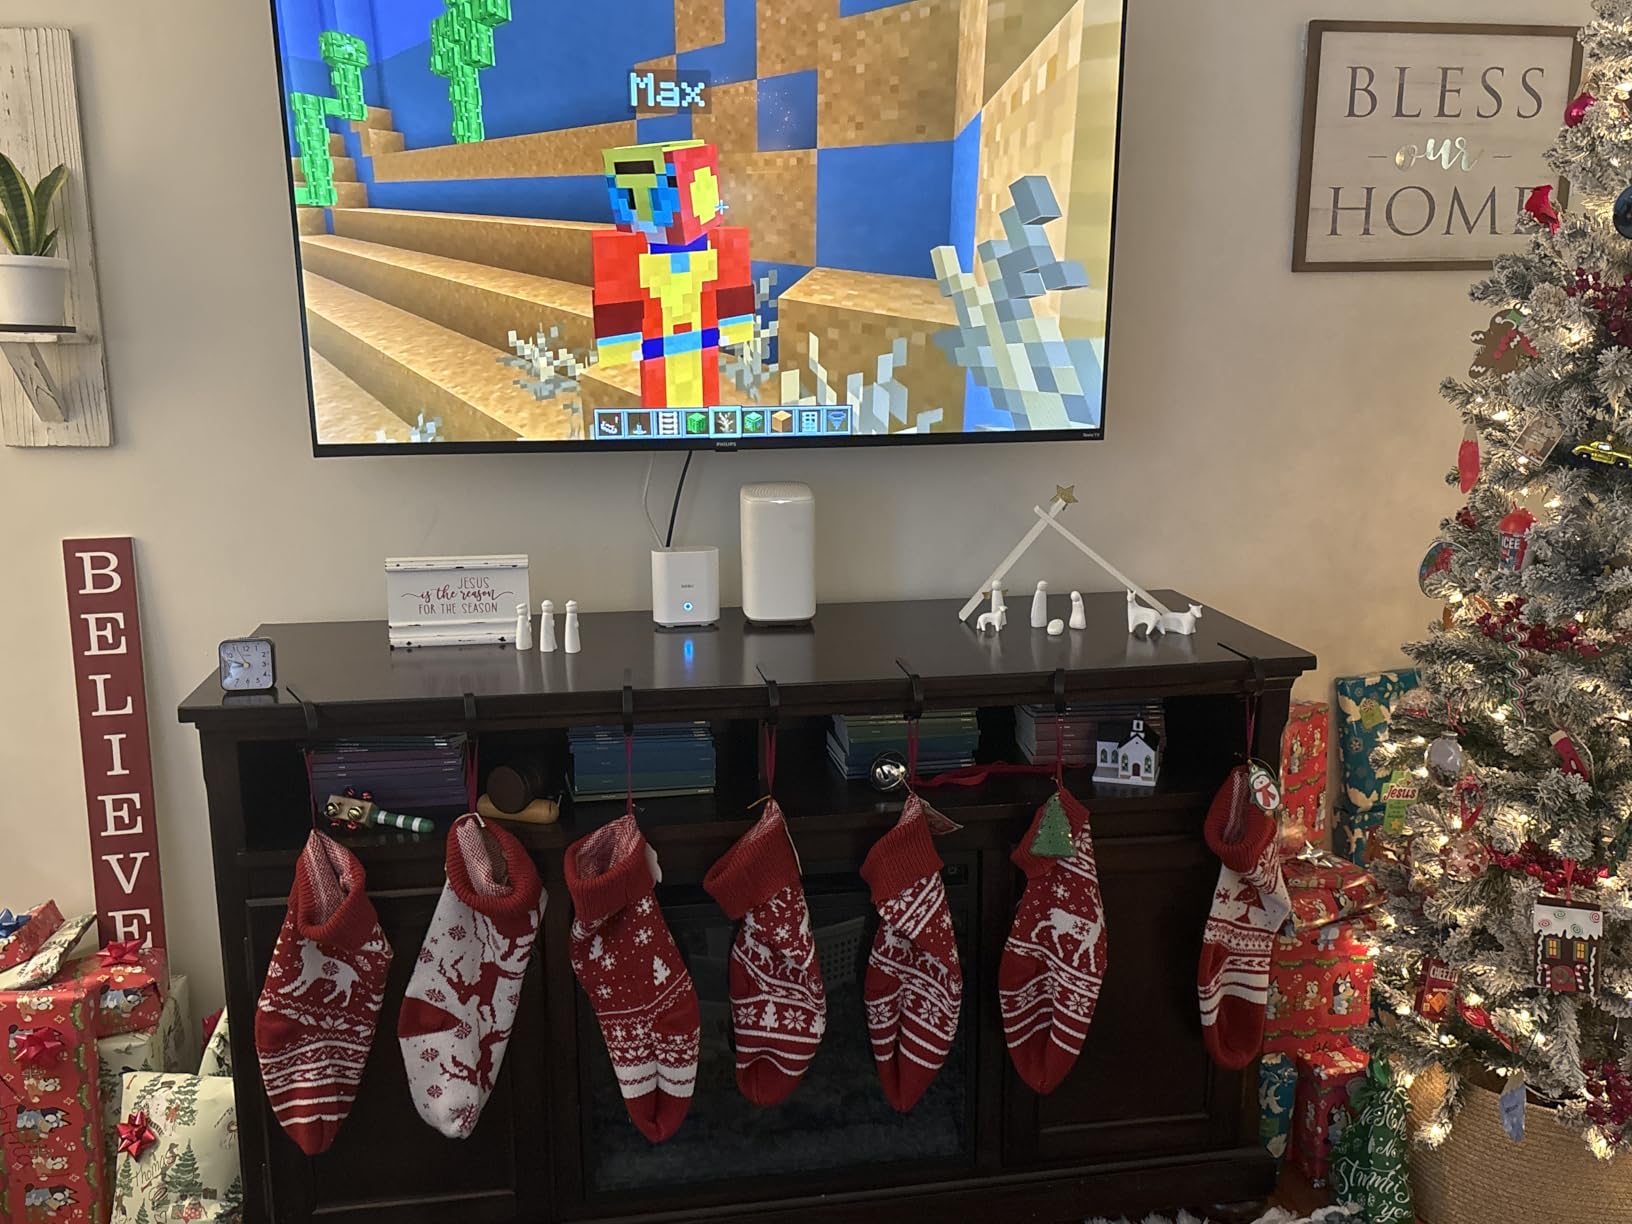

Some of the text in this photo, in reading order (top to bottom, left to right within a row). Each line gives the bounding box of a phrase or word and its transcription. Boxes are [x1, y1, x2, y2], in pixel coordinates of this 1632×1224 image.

[629, 71, 706, 108] Max
[1343, 65, 1545, 119] BLESS
[1393, 136, 1479, 172] our
[431, 584, 457, 601] the
[460, 589, 501, 602] reason
[457, 576, 490, 590] JESUS
[418, 602, 498, 615] FOR THE SEASON
[74, 550, 154, 950] BELIEVE
[1383, 784, 1417, 801] Jesus
